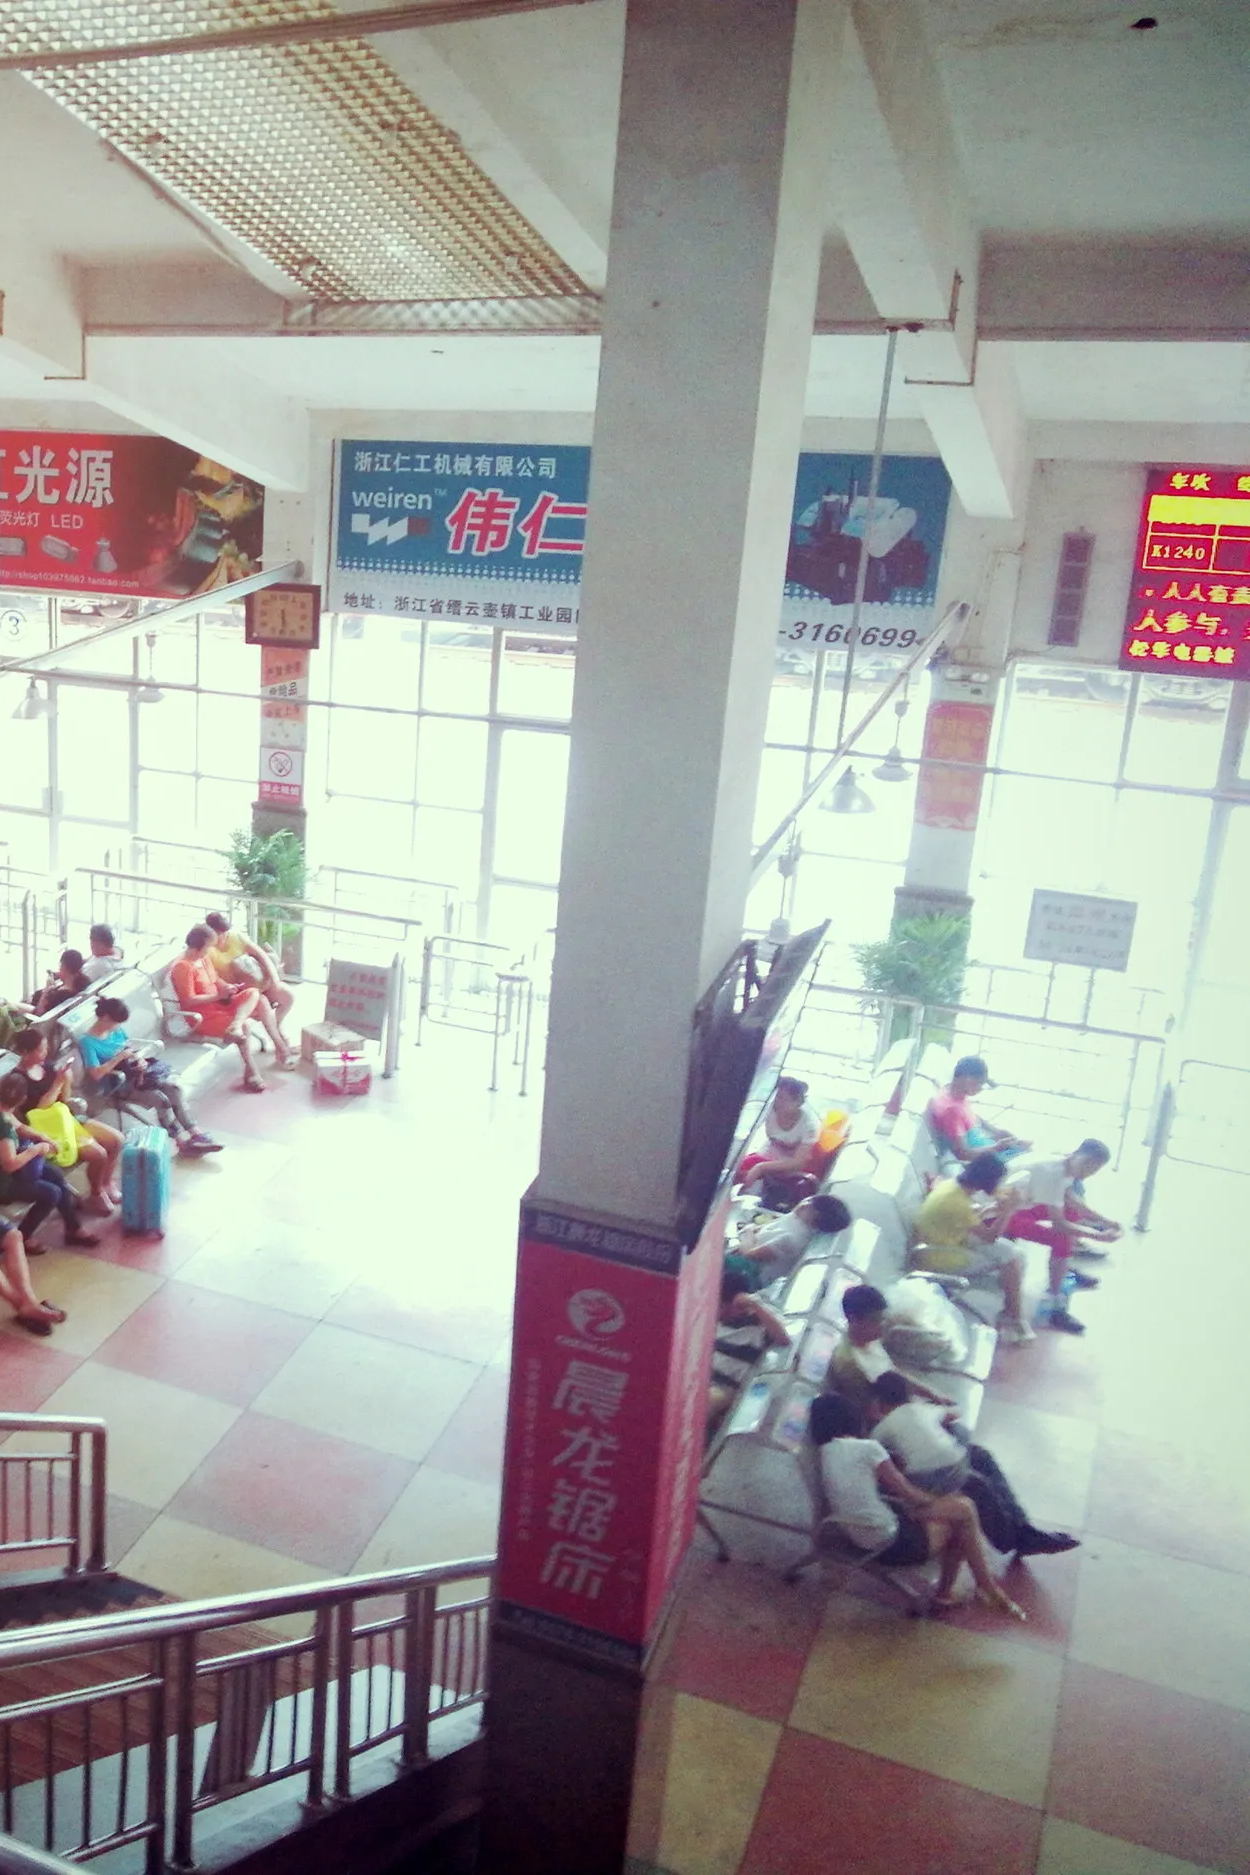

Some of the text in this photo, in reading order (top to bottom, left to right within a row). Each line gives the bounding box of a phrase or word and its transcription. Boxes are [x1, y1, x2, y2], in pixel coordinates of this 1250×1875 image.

[354, 451, 557, 479] 浙江仁工机械有限公司
[352, 486, 432, 510] weiren
[51, 514, 84, 529] LED
[445, 487, 588, 559] 伟仁
[539, 1359, 630, 1600] 晨龙锯床
